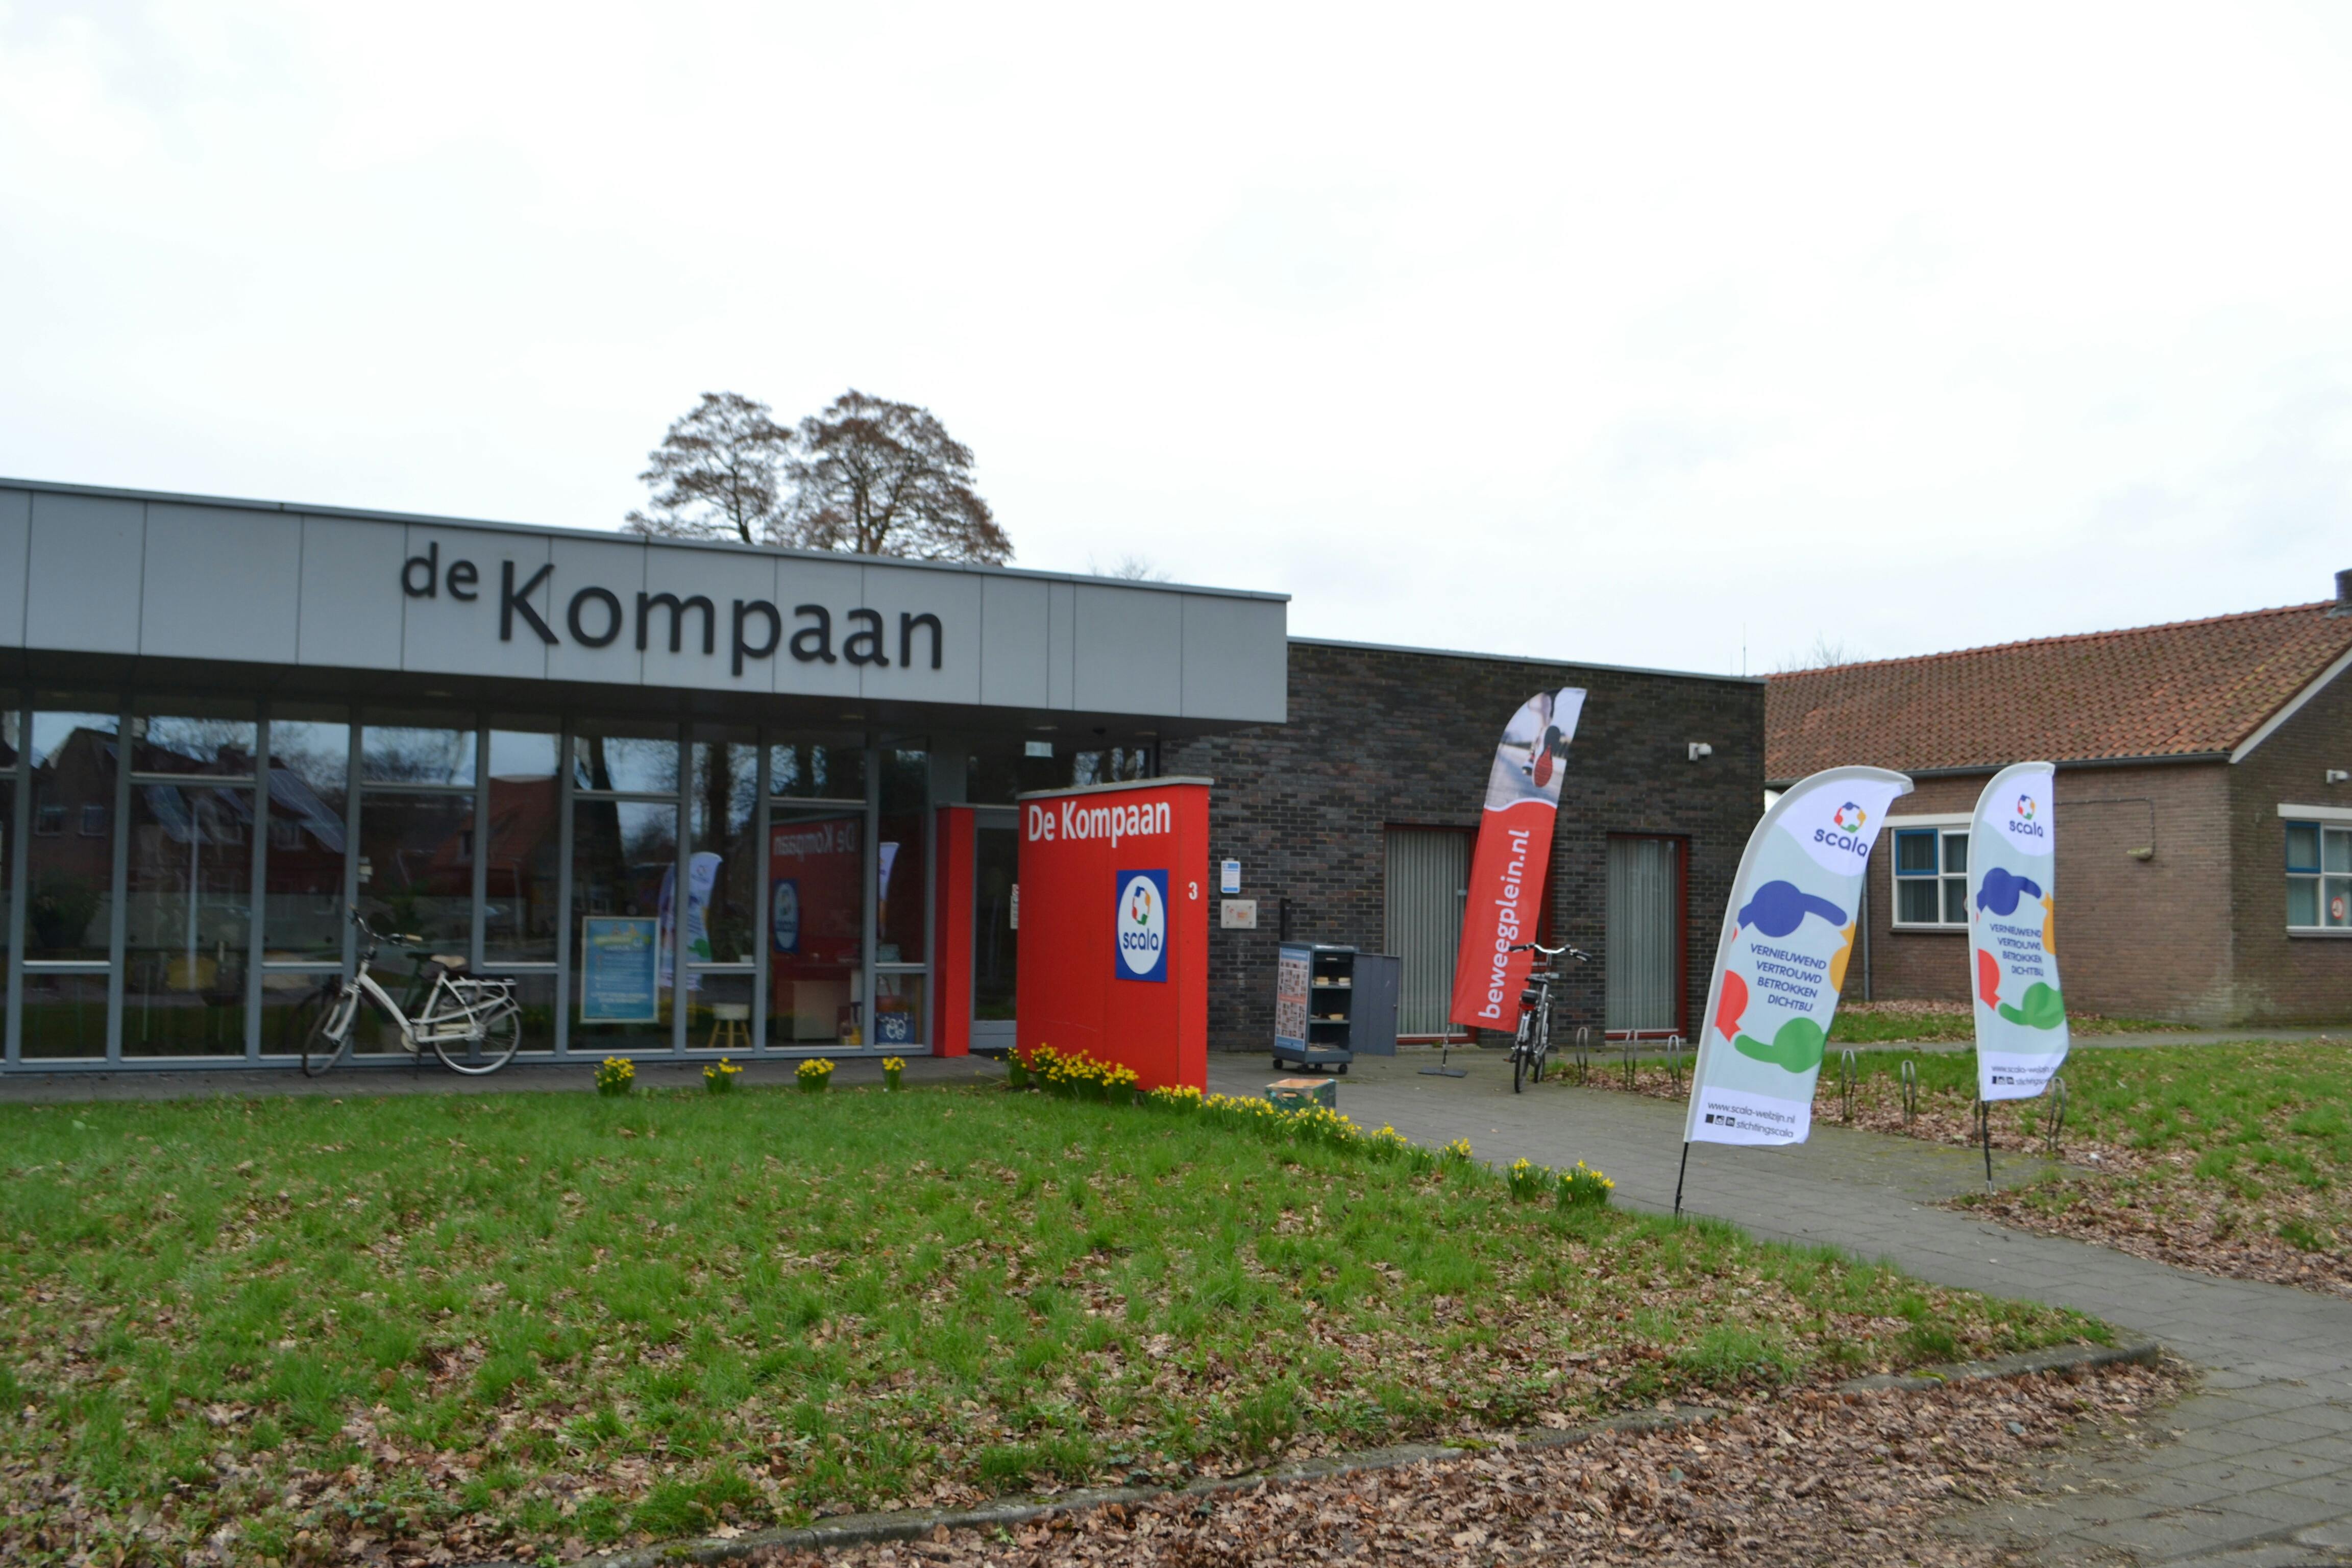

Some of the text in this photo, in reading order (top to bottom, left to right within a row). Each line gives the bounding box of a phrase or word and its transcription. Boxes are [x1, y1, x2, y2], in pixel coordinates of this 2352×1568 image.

[401, 542, 943, 677] de Kompaan
[1028, 801, 1170, 848] De Kompaan
[2009, 820, 2043, 838] scala
[1814, 828, 1868, 857] scala
[1189, 881, 1198, 900] 3
[1478, 829, 1530, 1019] beweegplein.nl
[1122, 928, 1159, 951] scala
[1750, 943, 1827, 970] VERNIEUWEND
[1756, 960, 1822, 984] VERTROUWD
[1757, 976, 1818, 998] BETROKKEN
[1767, 994, 1814, 1012] DICHTBIJ
[1708, 1102, 1796, 1124] www.scala-welzijn.nl
[1736, 1121, 1794, 1138] stichtingscala
